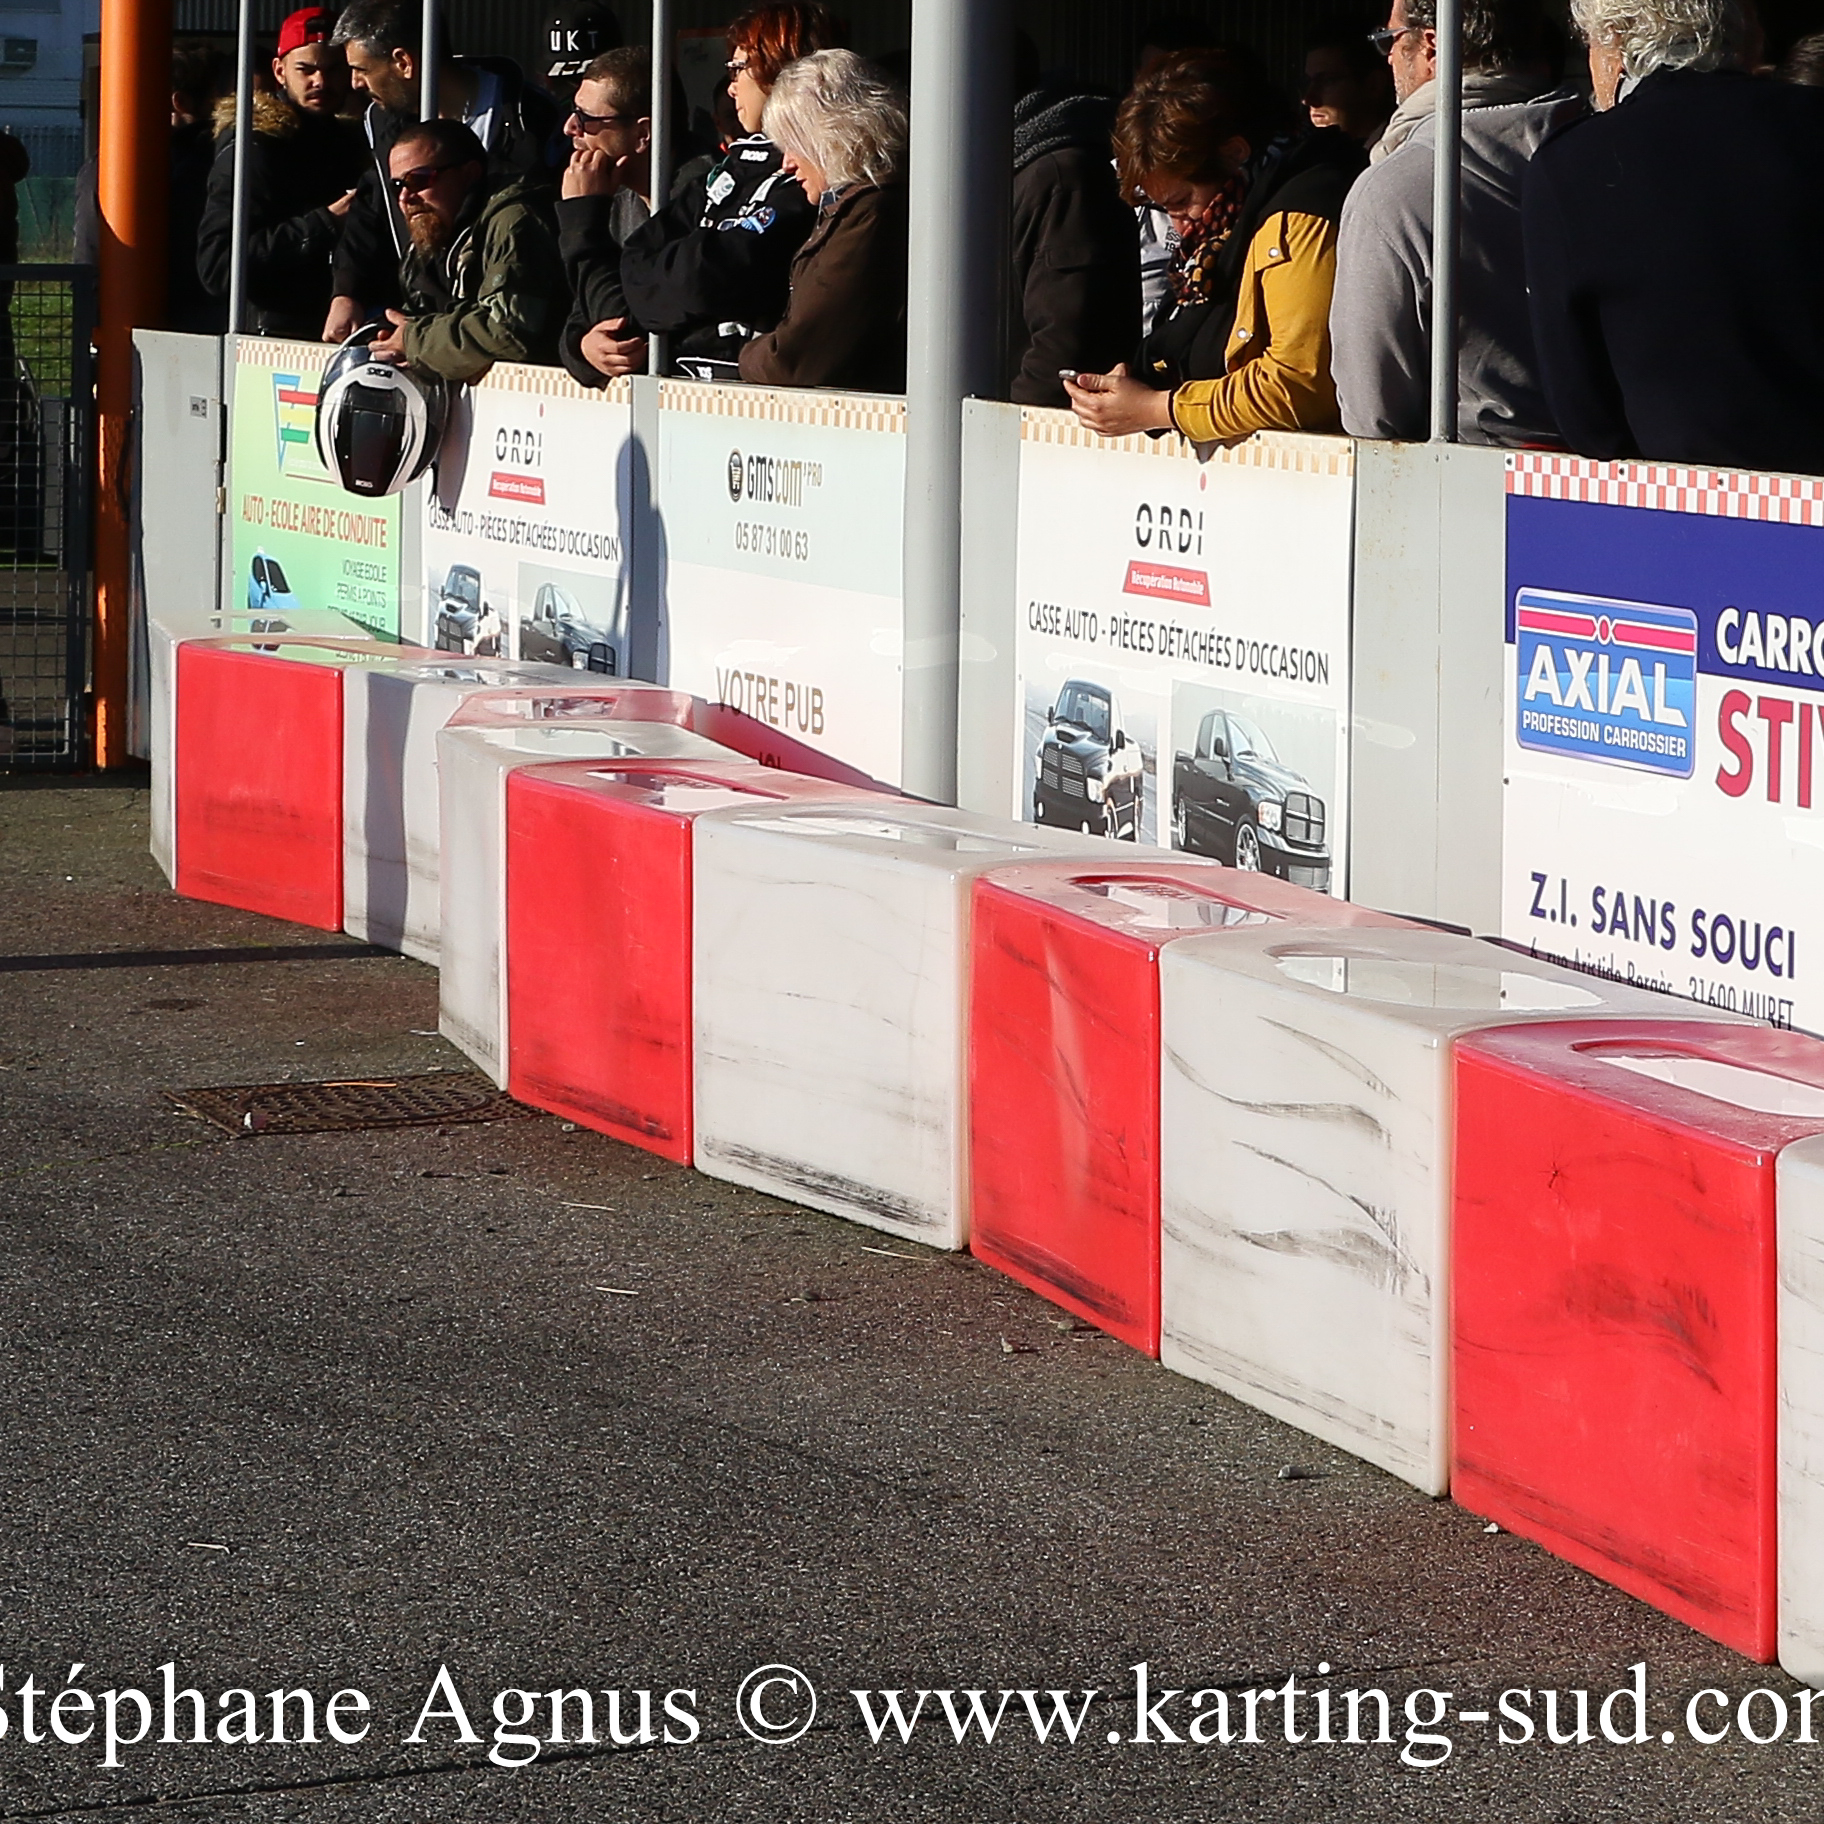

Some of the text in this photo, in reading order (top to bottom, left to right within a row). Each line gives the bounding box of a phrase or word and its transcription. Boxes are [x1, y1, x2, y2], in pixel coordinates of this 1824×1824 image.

[495, 427, 543, 467] ORDI
[242, 494, 264, 524] AUTO
[270, 499, 299, 531] ECOLE
[300, 504, 321, 536] AIRE
[323, 508, 335, 539] DE
[337, 512, 387, 548] CONDUITE
[452, 509, 474, 535] AUTO
[479, 509, 507, 543] PIÈCES
[509, 514, 557, 552] DÉTACHÉES
[559, 529, 619, 562] D'OCCASION
[735, 521, 808, 561] 05 87 31 00 63
[1135, 503, 1204, 555] ORDI
[1029, 600, 1062, 636] CASSE
[1063, 608, 1098, 643] AUTO
[1109, 611, 1155, 653] PIÈCES
[1158, 619, 1232, 669] DÉTACHÉES
[1235, 638, 1330, 686] D'OCCASION
[716, 665, 825, 736] VOTRE PUB
[1524, 643, 1688, 727] AXIAL
[1522, 710, 1688, 758] PROFESSION CARROSSIER
[1529, 871, 1795, 979] Z.I. SANS SOUCI
[1689, 976, 1737, 1012] 31600
[1742, 990, 1795, 1030] MURET
